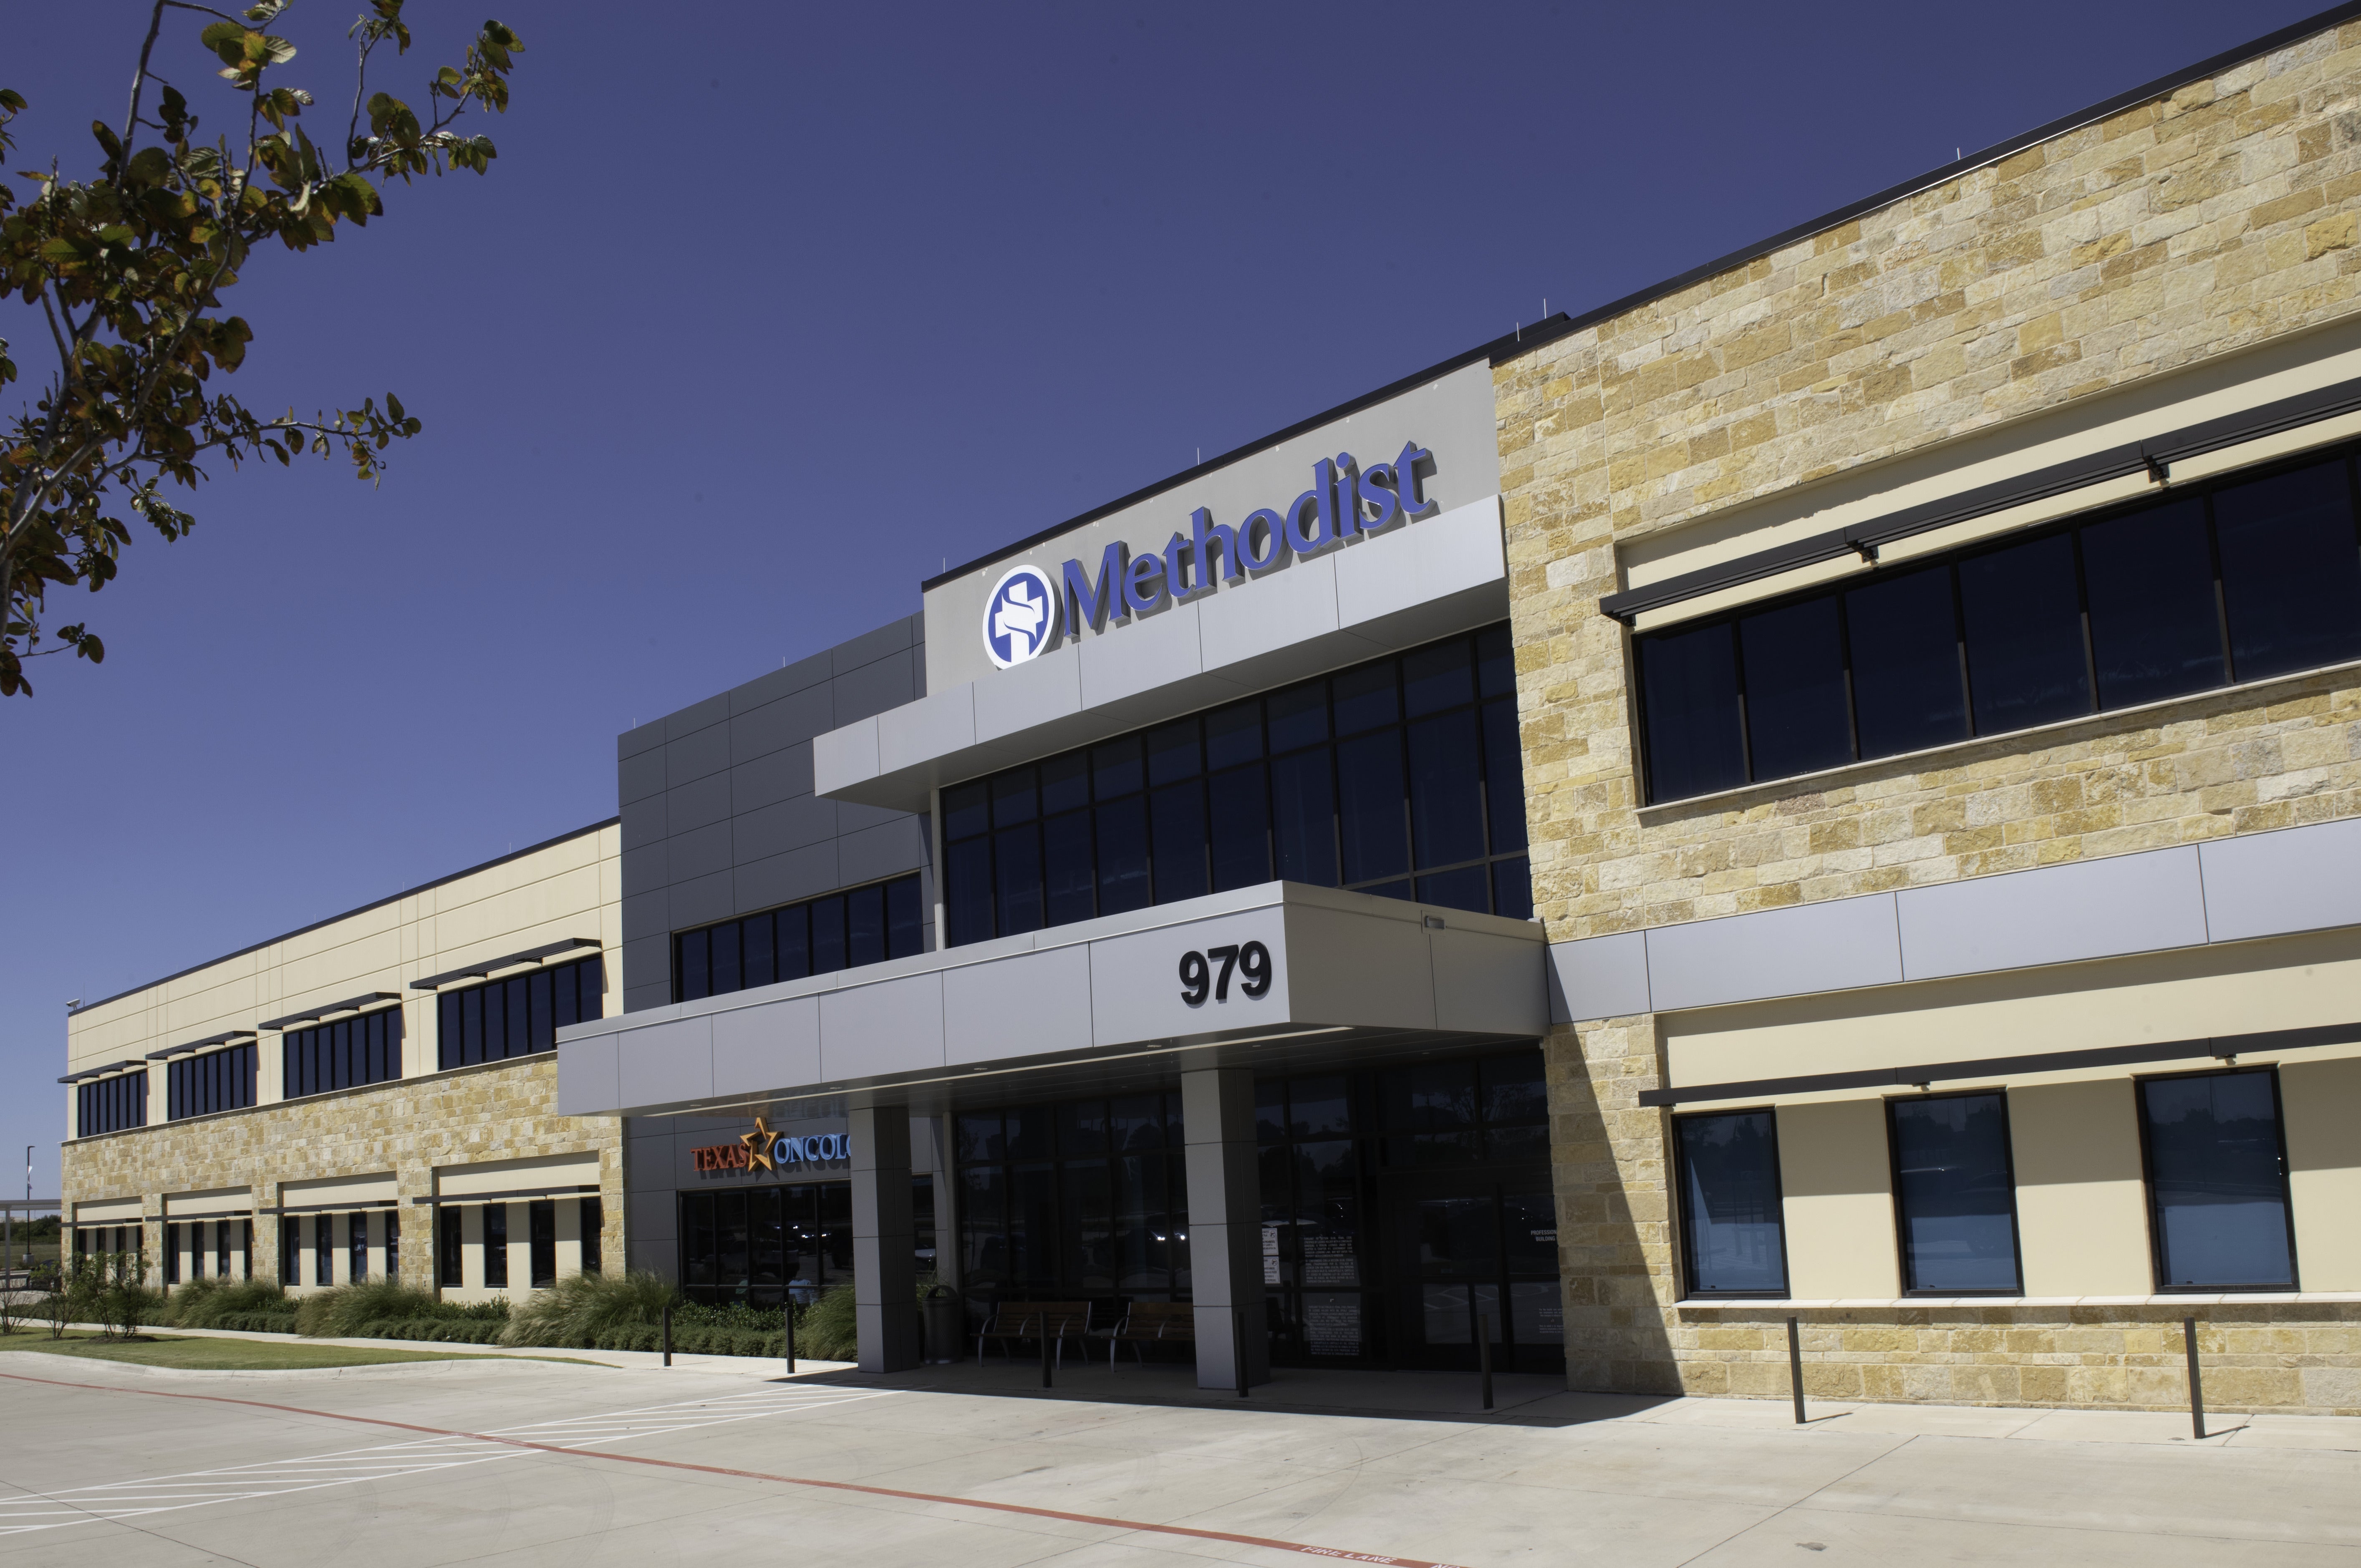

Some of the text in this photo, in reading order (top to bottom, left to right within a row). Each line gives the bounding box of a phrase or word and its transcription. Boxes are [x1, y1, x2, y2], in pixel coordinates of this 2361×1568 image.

[1061, 441, 1437, 638] Methodist
[1179, 940, 1271, 1004] 979
[690, 1142, 751, 1171] TEXAS
[1300, 1546, 1397, 1563] FIRE LANE
